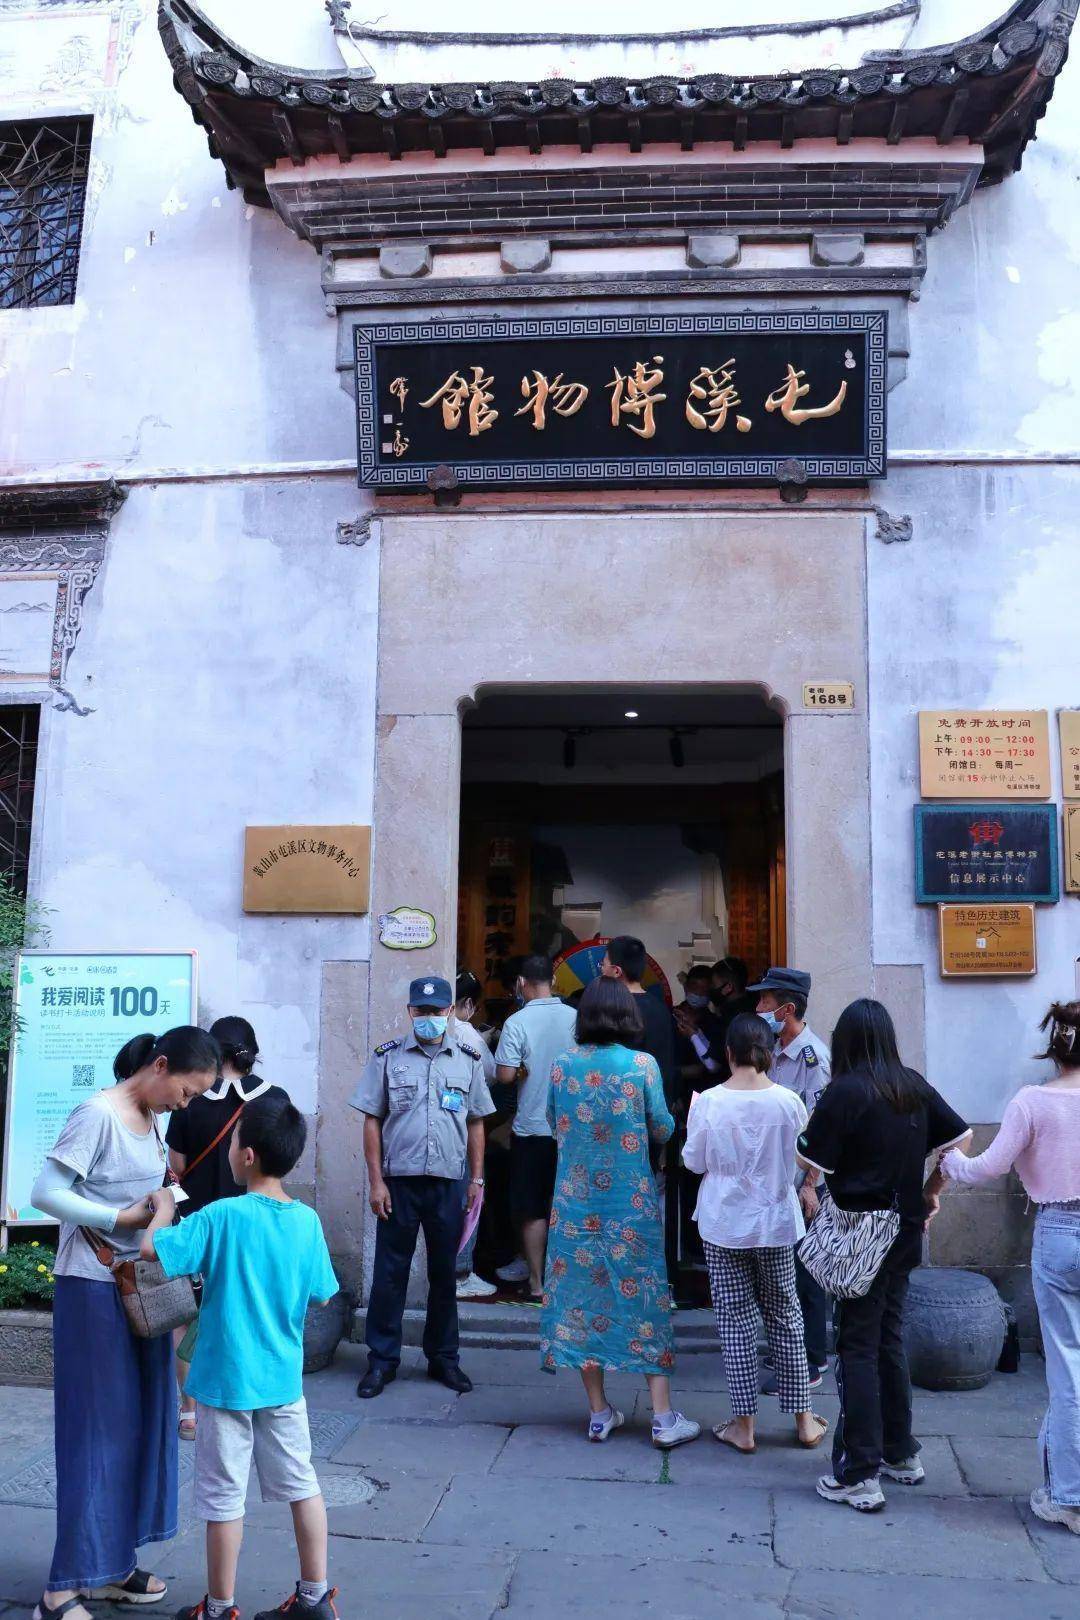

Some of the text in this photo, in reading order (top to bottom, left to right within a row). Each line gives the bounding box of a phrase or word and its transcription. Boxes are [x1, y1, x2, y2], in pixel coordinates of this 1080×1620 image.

[810, 694, 847, 705] 168号
[937, 718, 1031, 729] 免费开放时间
[995, 760, 1023, 770] 每周一
[252, 838, 360, 878] 黄山市屯溪区文物事务中心
[949, 873, 1026, 884] 信息展示中心
[954, 910, 1021, 921] 特色历史建筑
[40, 1008, 106, 1018] 读书打卡活动说明
